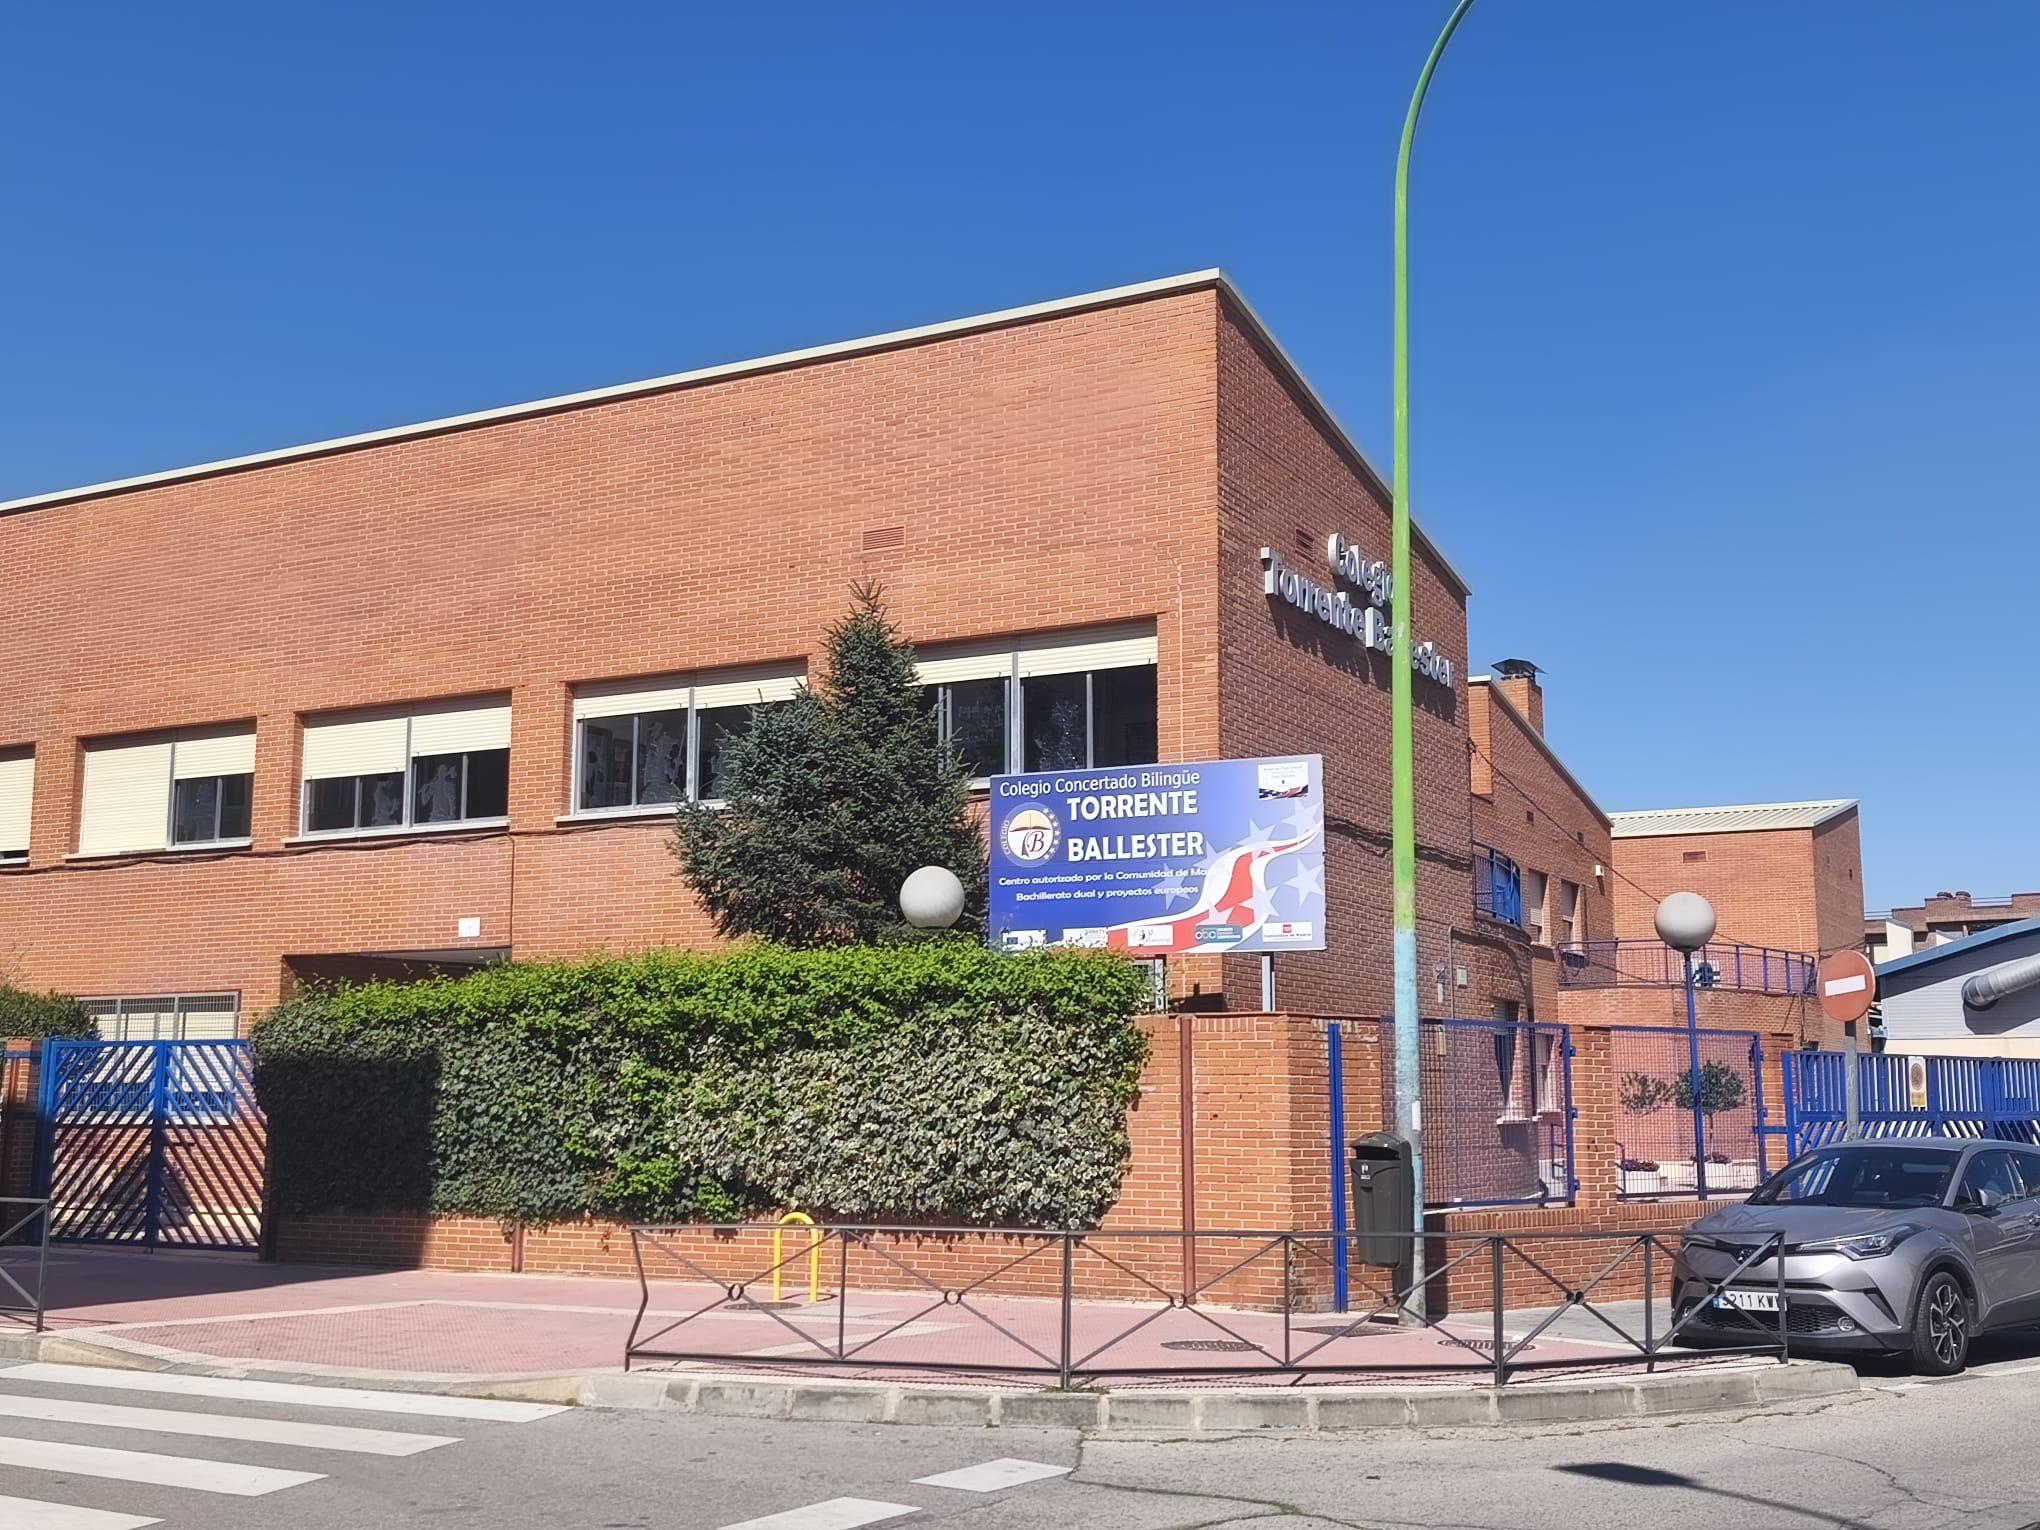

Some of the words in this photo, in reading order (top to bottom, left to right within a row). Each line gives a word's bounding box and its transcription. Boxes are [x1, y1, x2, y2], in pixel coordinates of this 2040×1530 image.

[1260, 546, 1365, 641] Torrente
[1365, 606, 1454, 688] Baester
[1000, 781, 1051, 797] Colegio
[1055, 774, 1137, 793] Concertado
[1141, 769, 1200, 789] Bilingüe
[1067, 790, 1198, 821] TORRENTE
[1068, 831, 1204, 862] BALLESTER
[998, 877, 1030, 886] Centro
[1031, 873, 1084, 884] autorizado
[1085, 873, 1102, 883] por
[1104, 872, 1114, 880] la
[1116, 869, 1174, 880] Comunidad
[1175, 868, 1188, 877] de
[1016, 891, 1072, 901] Bachillerato
[1073, 889, 1096, 899] dual
[1097, 890, 1104, 899] y
[1106, 887, 1152, 898] proyectos
[1154, 886, 1199, 896] europeos
